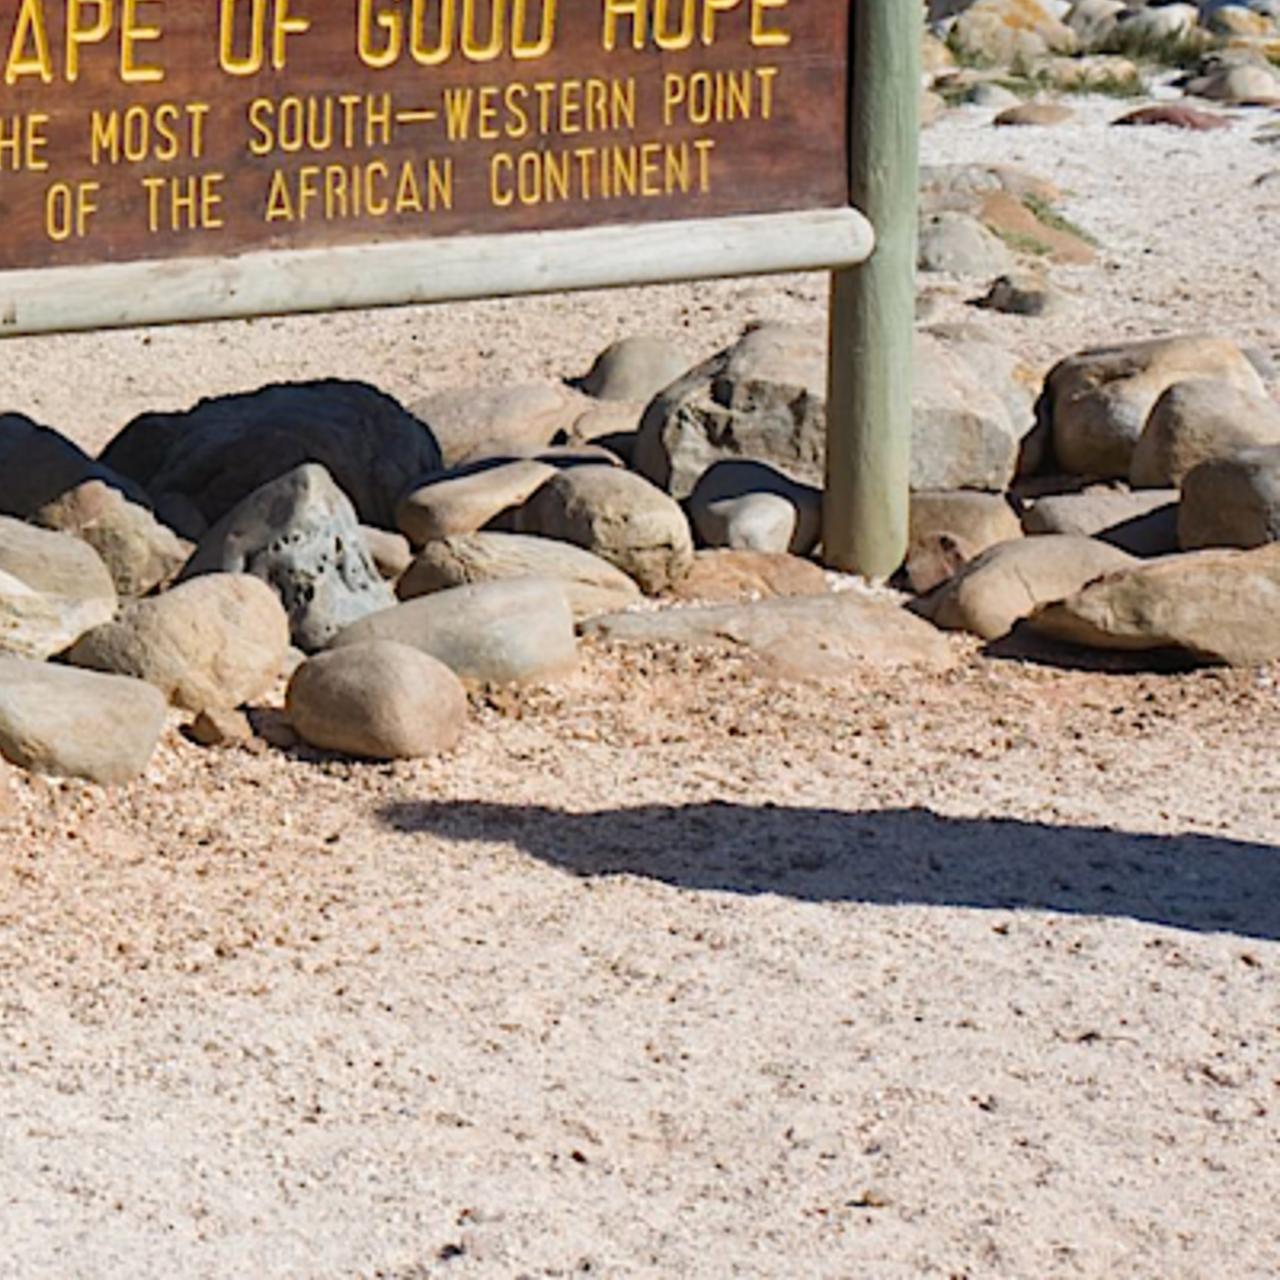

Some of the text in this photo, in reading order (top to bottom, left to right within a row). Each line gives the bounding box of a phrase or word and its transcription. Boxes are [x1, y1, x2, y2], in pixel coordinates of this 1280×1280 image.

[89, 101, 211, 166] MOST
[663, 66, 779, 125] POINT
[45, 138, 717, 242] OF THE AFRICAN CONTINENT
